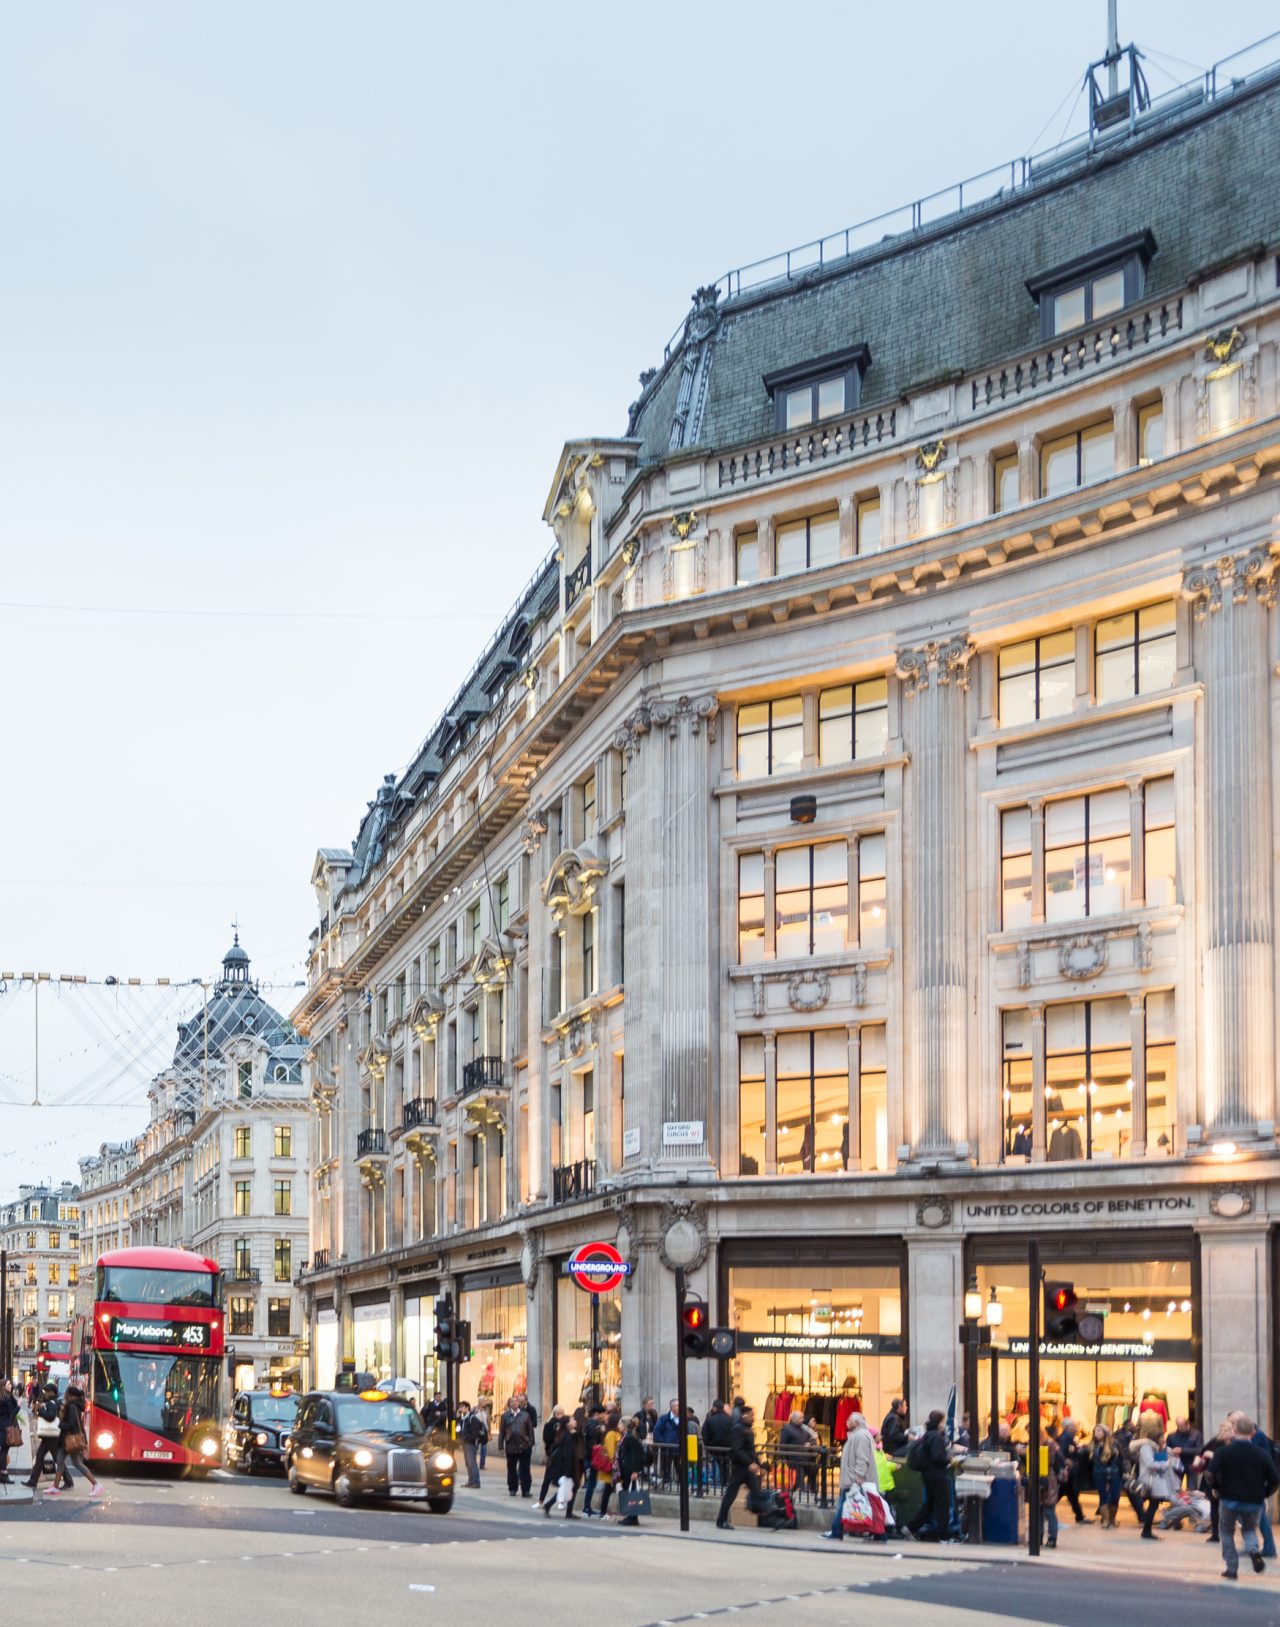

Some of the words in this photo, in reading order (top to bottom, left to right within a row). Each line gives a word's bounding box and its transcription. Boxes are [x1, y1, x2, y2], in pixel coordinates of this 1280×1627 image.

[967, 1204, 1018, 1217] UNITED
[1021, 1202, 1080, 1216] COLORS
[1084, 1201, 1104, 1213] OF
[570, 1263, 628, 1272] UNDERGROUND
[116, 1323, 173, 1338] Marylebone
[183, 1326, 204, 1343] 453
[753, 1337, 783, 1347] UNITED
[783, 1338, 816, 1348] COLORS
[816, 1339, 828, 1348] OF
[1012, 1342, 1046, 1353] UNID
